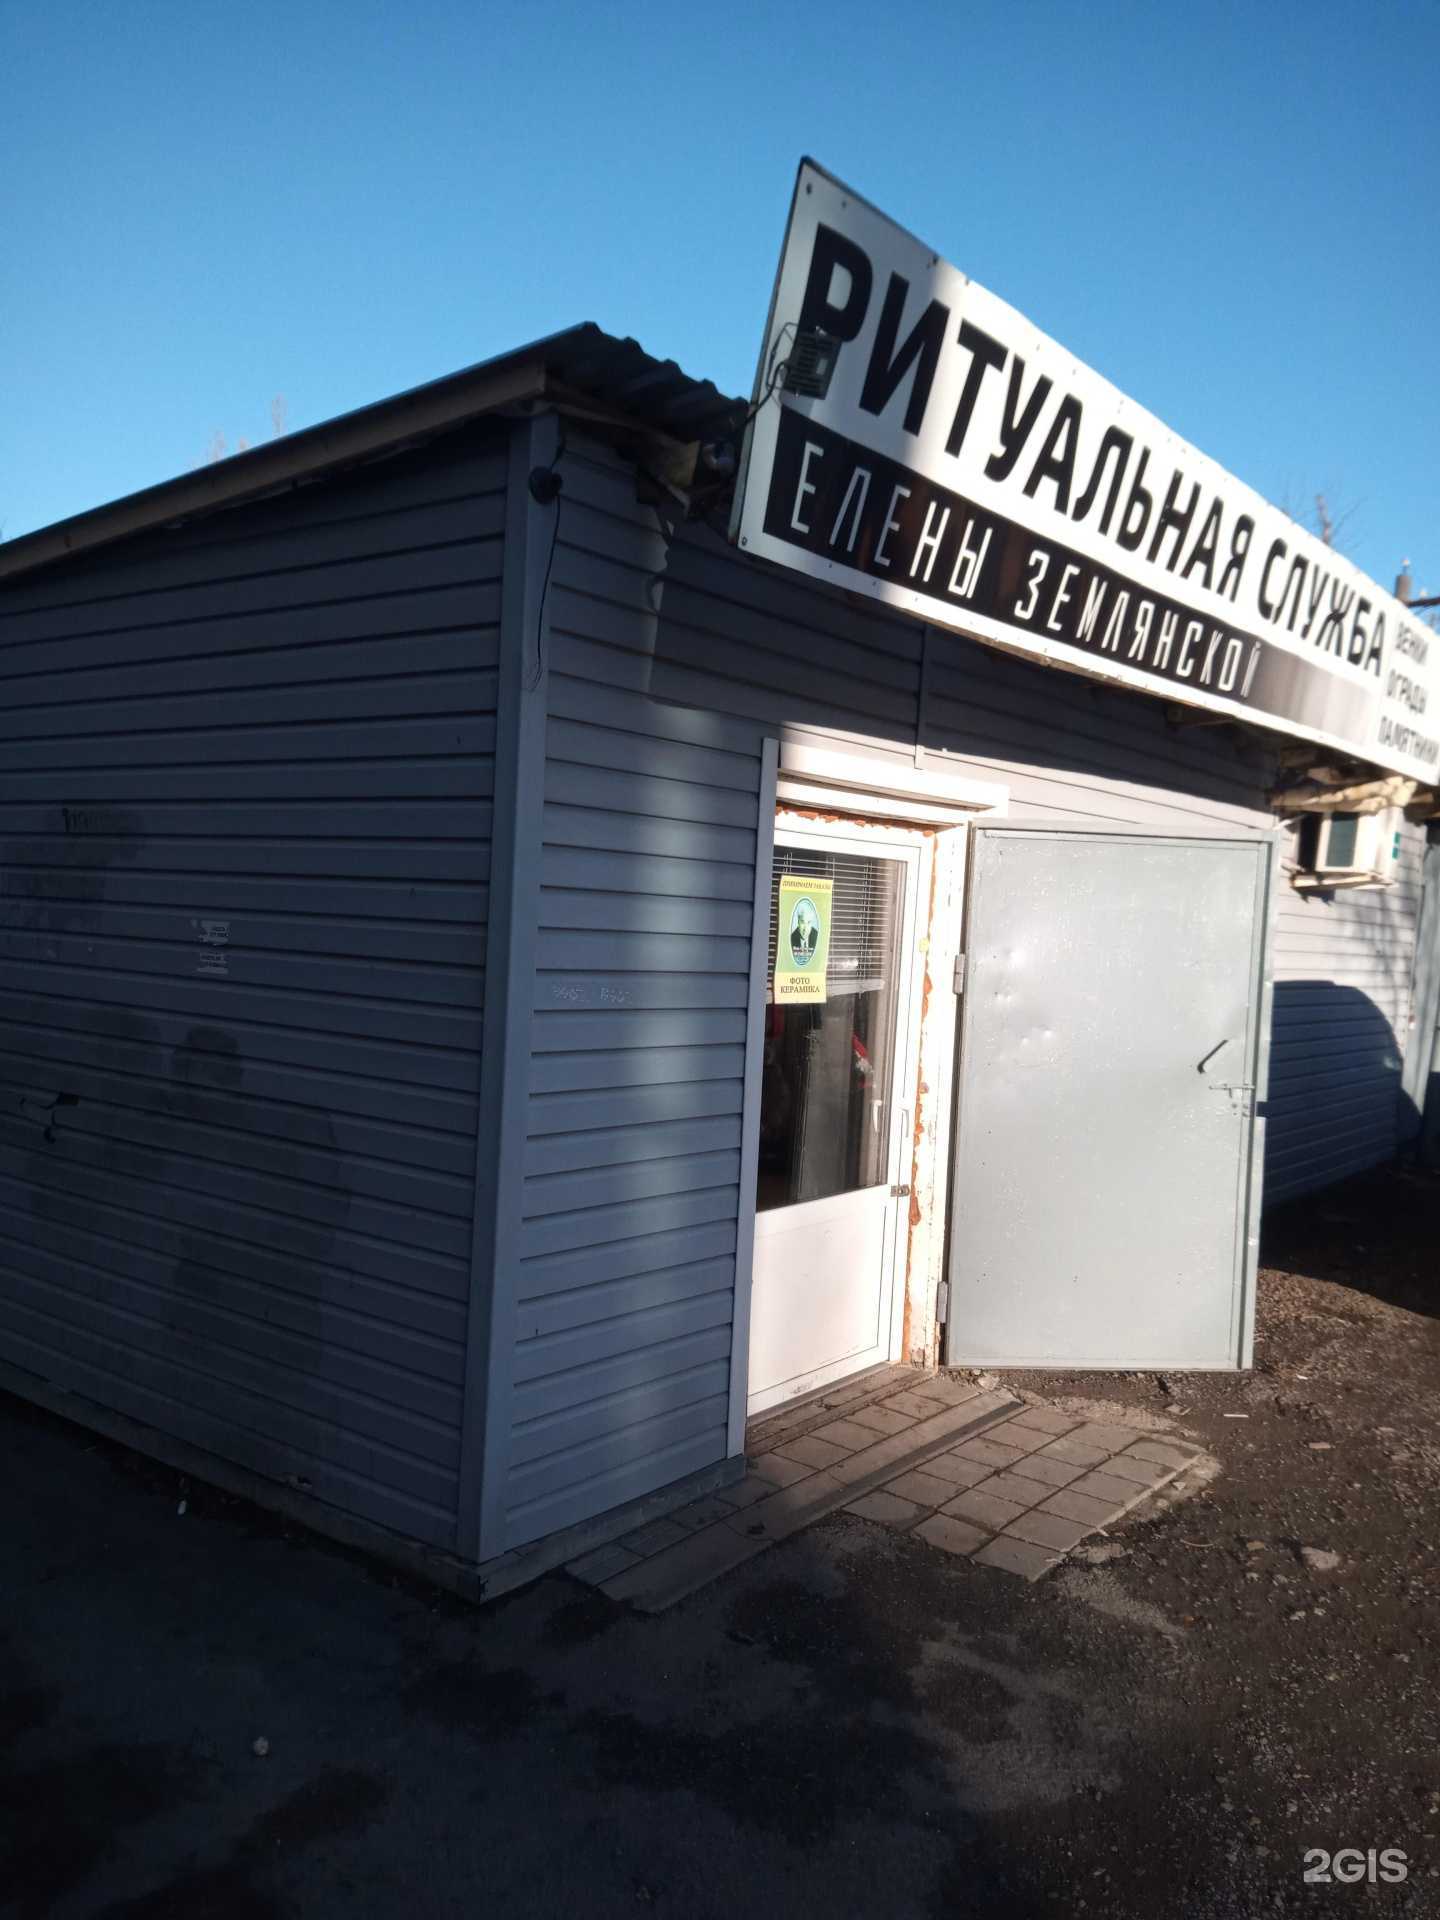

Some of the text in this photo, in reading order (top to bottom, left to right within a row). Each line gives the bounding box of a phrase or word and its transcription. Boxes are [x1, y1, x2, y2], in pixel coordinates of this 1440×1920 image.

[797, 222, 1388, 677] РИТУАЛЬНАЯ СЛУЖБА
[790, 440, 1263, 699] ЕЛЕНЫ ЗЕМЛЯНСКОЙ
[780, 985, 820, 994] КЕРАМИКА
[789, 977, 811, 985] ФОТО
